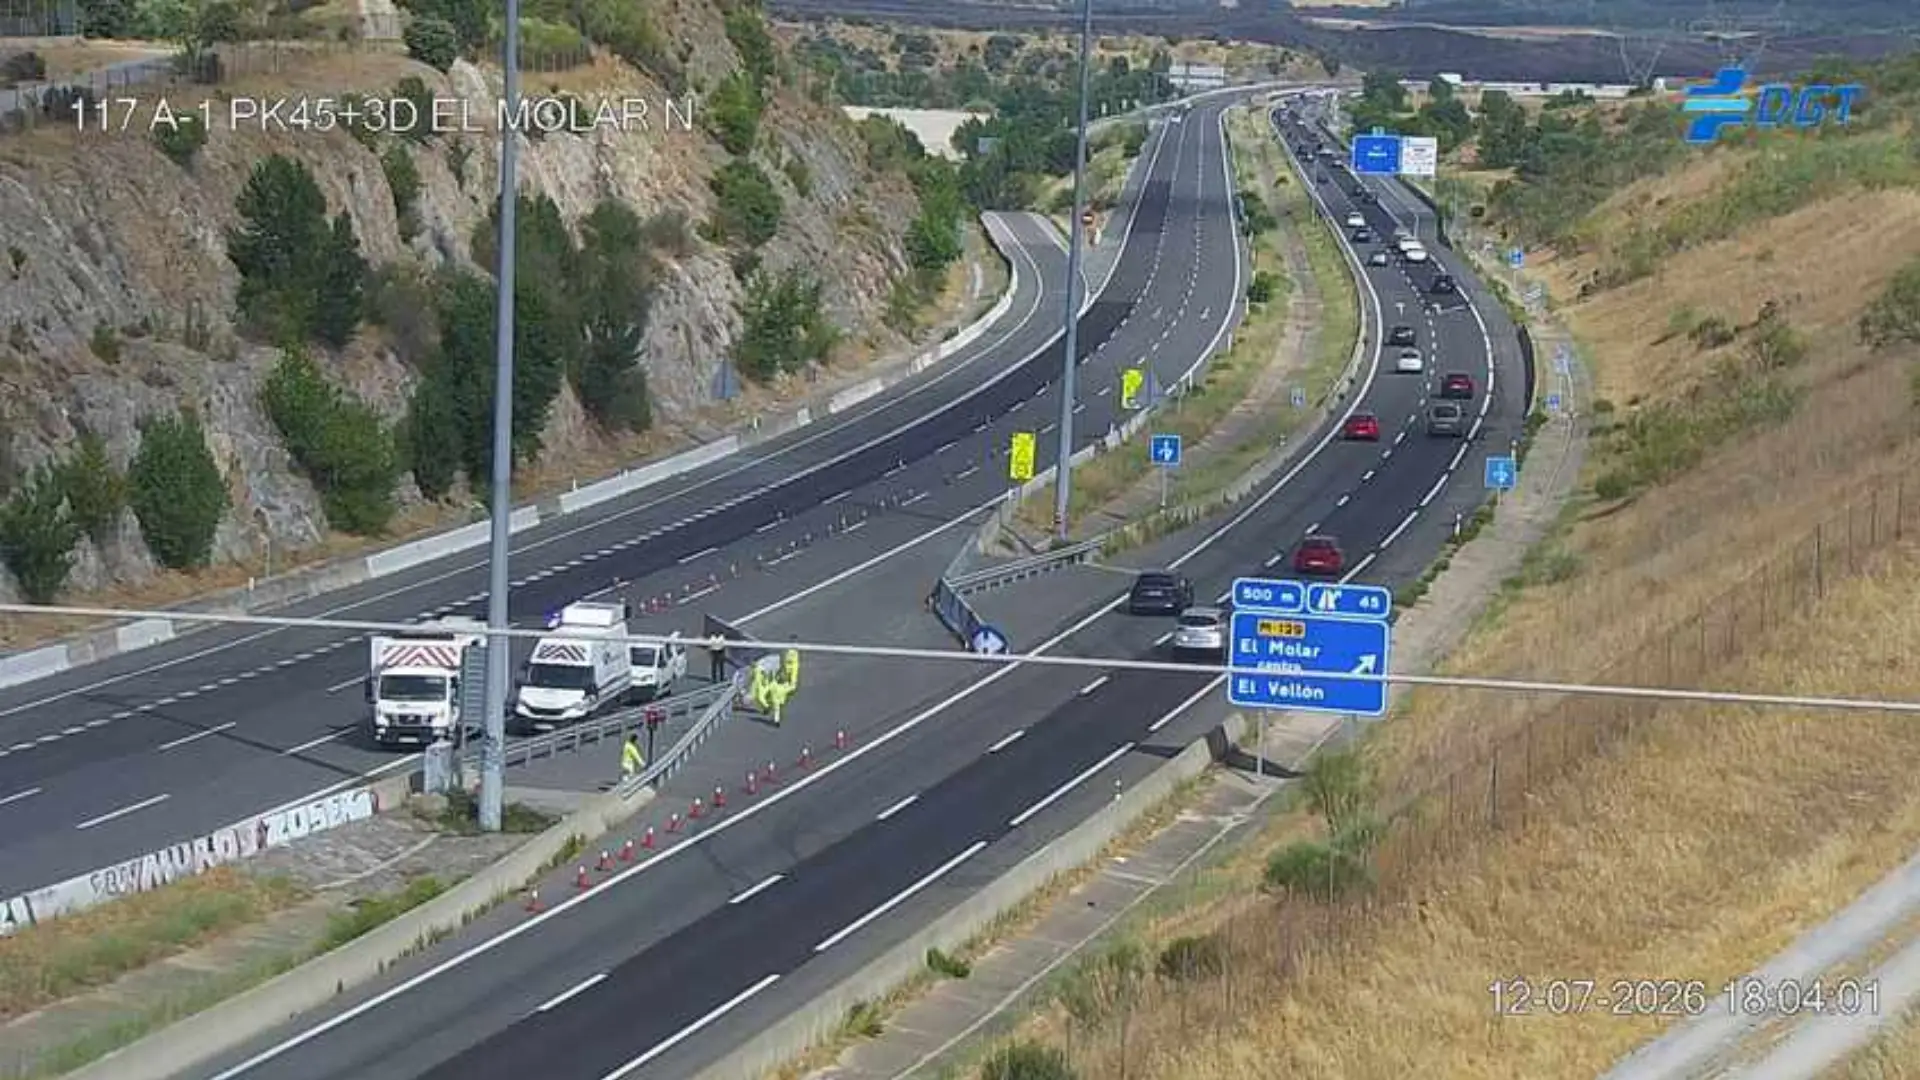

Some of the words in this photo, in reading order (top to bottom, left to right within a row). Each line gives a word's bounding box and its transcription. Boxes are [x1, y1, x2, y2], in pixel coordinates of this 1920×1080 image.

[1242, 585, 1273, 601] 500
[1281, 592, 1296, 603] m
[1359, 595, 1380, 610] 45
[1240, 638, 1258, 654] El
[1268, 640, 1321, 658] Molar
[1238, 678, 1257, 695] El
